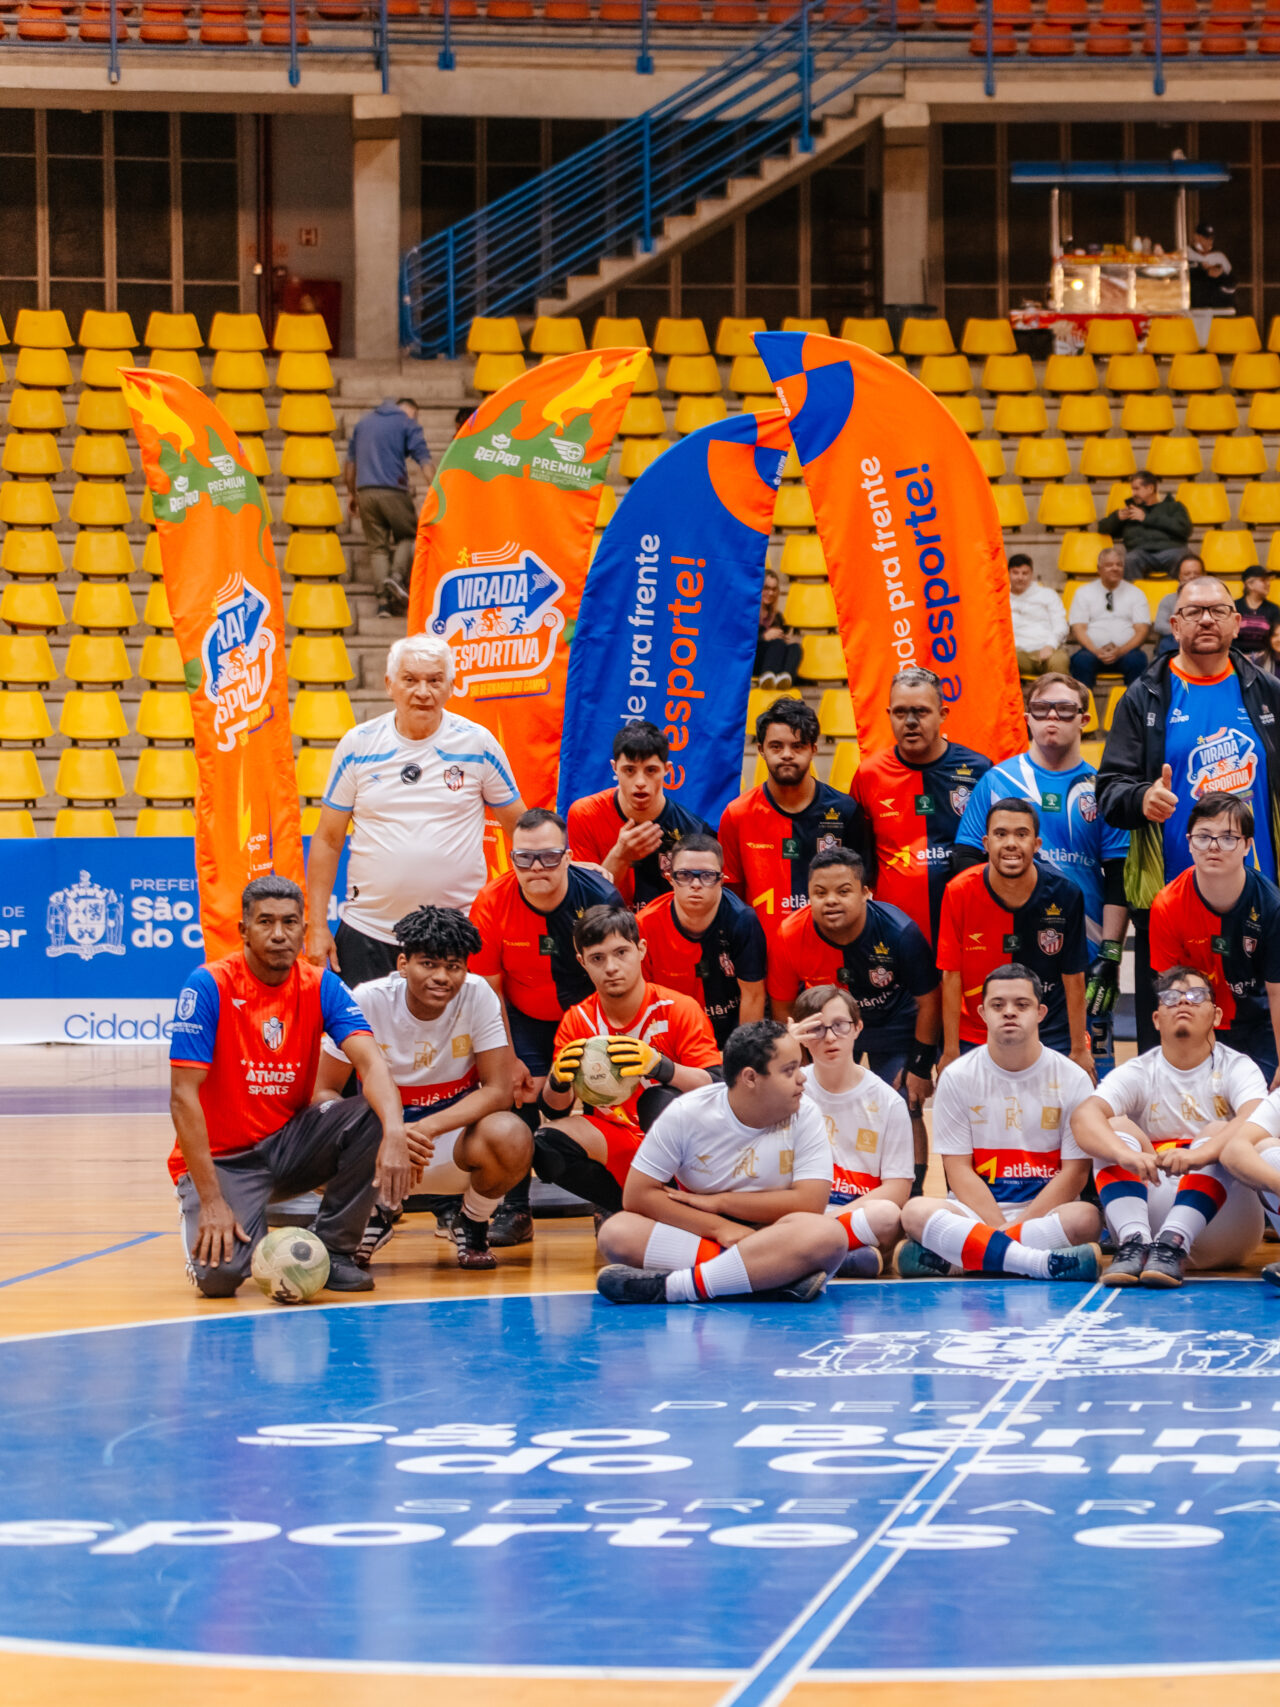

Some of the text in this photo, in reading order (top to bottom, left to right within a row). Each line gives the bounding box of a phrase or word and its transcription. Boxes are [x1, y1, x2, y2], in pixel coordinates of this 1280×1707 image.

[531, 456, 593, 480] PREMIUM
[207, 475, 247, 494] PREMIUM
[860, 456, 897, 552] frente
[895, 463, 960, 664] esporte!
[457, 573, 529, 609] VIRADA
[627, 534, 661, 627] frente
[882, 556, 915, 612] pra
[453, 637, 540, 673] ESPORTIVA
[629, 634, 657, 688] pra
[664, 556, 706, 752] esporte!
[1199, 739, 1240, 766] VIRADA
[1202, 769, 1250, 793] ESPORTIVA
[2, 905, 25, 918] DE
[131, 896, 194, 922] São
[131, 922, 174, 949] do
[64, 1012, 175, 1041] Cidade
[245, 1070, 296, 1084] ATHOS
[248, 1084, 290, 1096] SPORTS
[237, 1422, 671, 1448] São
[395, 1447, 694, 1475] do
[0, 1517, 1018, 1555] sportes
[1074, 1523, 1226, 1549] e
